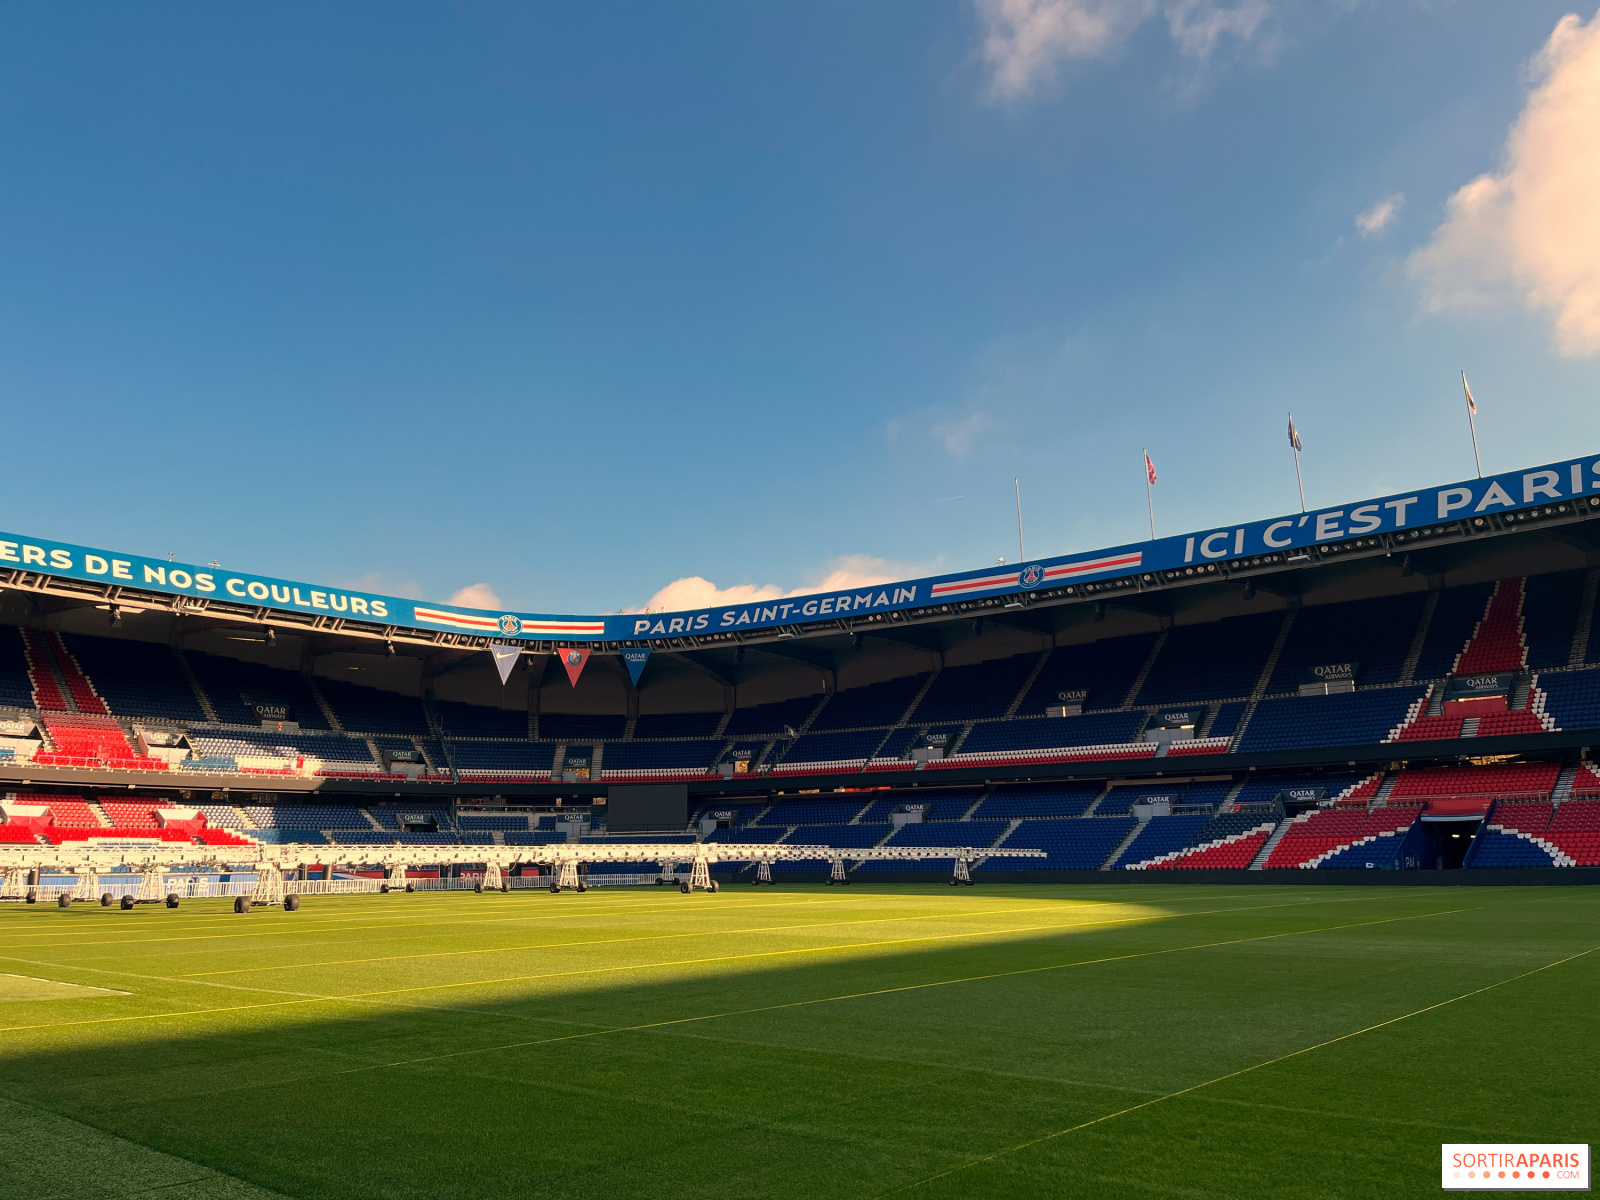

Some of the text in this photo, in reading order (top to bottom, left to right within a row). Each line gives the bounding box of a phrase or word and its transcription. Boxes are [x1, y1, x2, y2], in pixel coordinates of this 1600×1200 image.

[1183, 528, 1245, 563] ICI
[1262, 497, 1418, 548] C'EST
[0, 540, 389, 617] ERS DE NOS COULEURS
[634, 586, 917, 635] PARIS SAINT-GERMAIN
[1314, 663, 1351, 677] QATAR
[1325, 672, 1353, 680] AIRWAYS
[1466, 677, 1498, 687] QATAR
[1058, 690, 1087, 701] QATAR
[256, 705, 286, 715] QATAR
[1164, 712, 1189, 721] QATAR
[926, 733, 947, 741] QATAR
[1289, 790, 1316, 799] QATAR
[1147, 796, 1170, 804] QATAR
